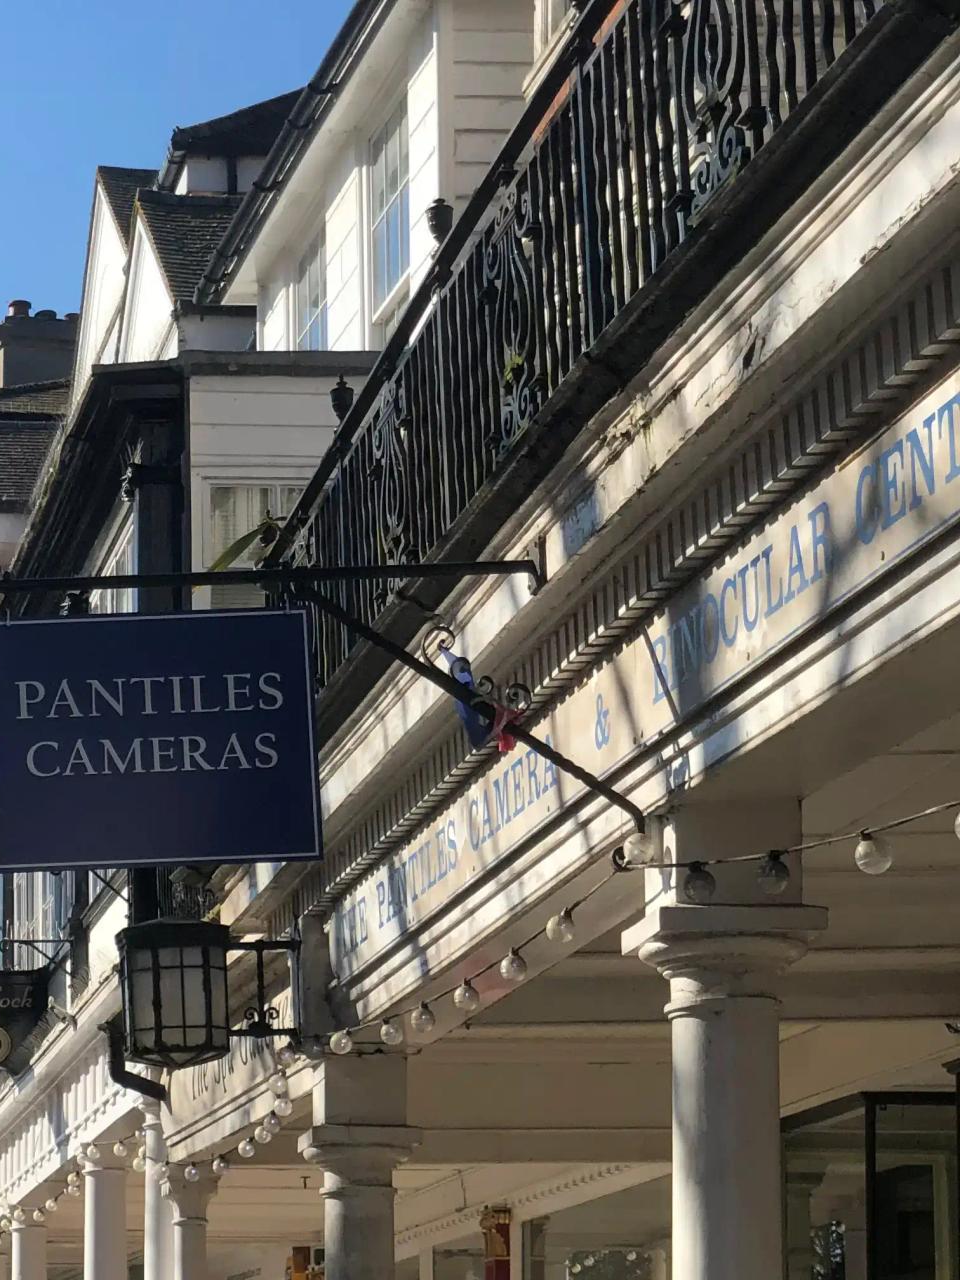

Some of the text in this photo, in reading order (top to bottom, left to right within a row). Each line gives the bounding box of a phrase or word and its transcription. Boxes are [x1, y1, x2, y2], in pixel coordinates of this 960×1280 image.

[14, 672, 284, 719] PANTILES
[339, 896, 368, 957] THE
[376, 819, 457, 929] PANTILES
[468, 734, 559, 851] CAMERA
[595, 694, 610, 750] &
[652, 501, 836, 704] BINOCULAR
[26, 732, 279, 777] CAMERAS
